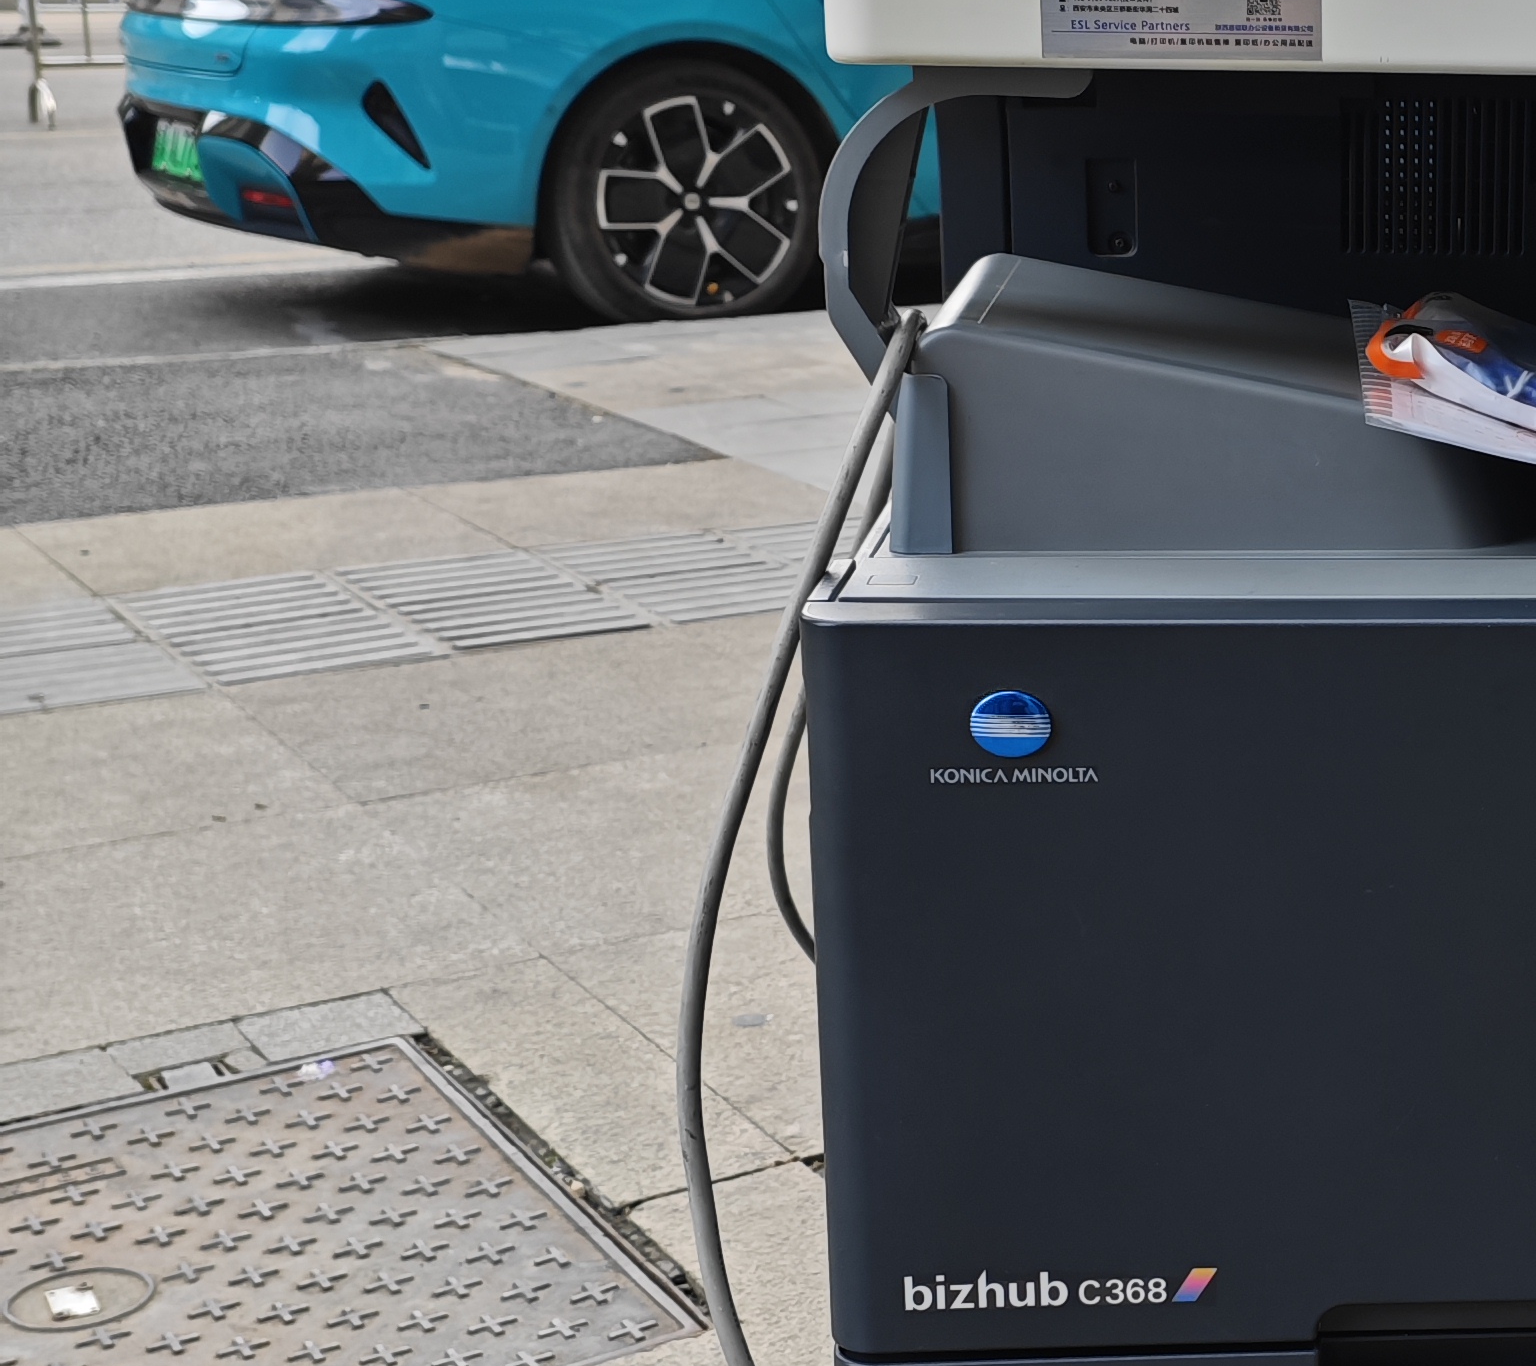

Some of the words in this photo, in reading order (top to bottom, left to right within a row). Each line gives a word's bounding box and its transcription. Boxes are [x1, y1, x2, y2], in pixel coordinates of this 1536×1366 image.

[1070, 19, 1091, 30] ESL
[1094, 19, 1138, 31] Service
[1141, 20, 1191, 32] Partners
[929, 767, 1009, 784] KONICA
[1011, 767, 1100, 783] MINOLTA
[903, 1269, 1069, 1311] bizhub
[1077, 1277, 1168, 1306] C368
